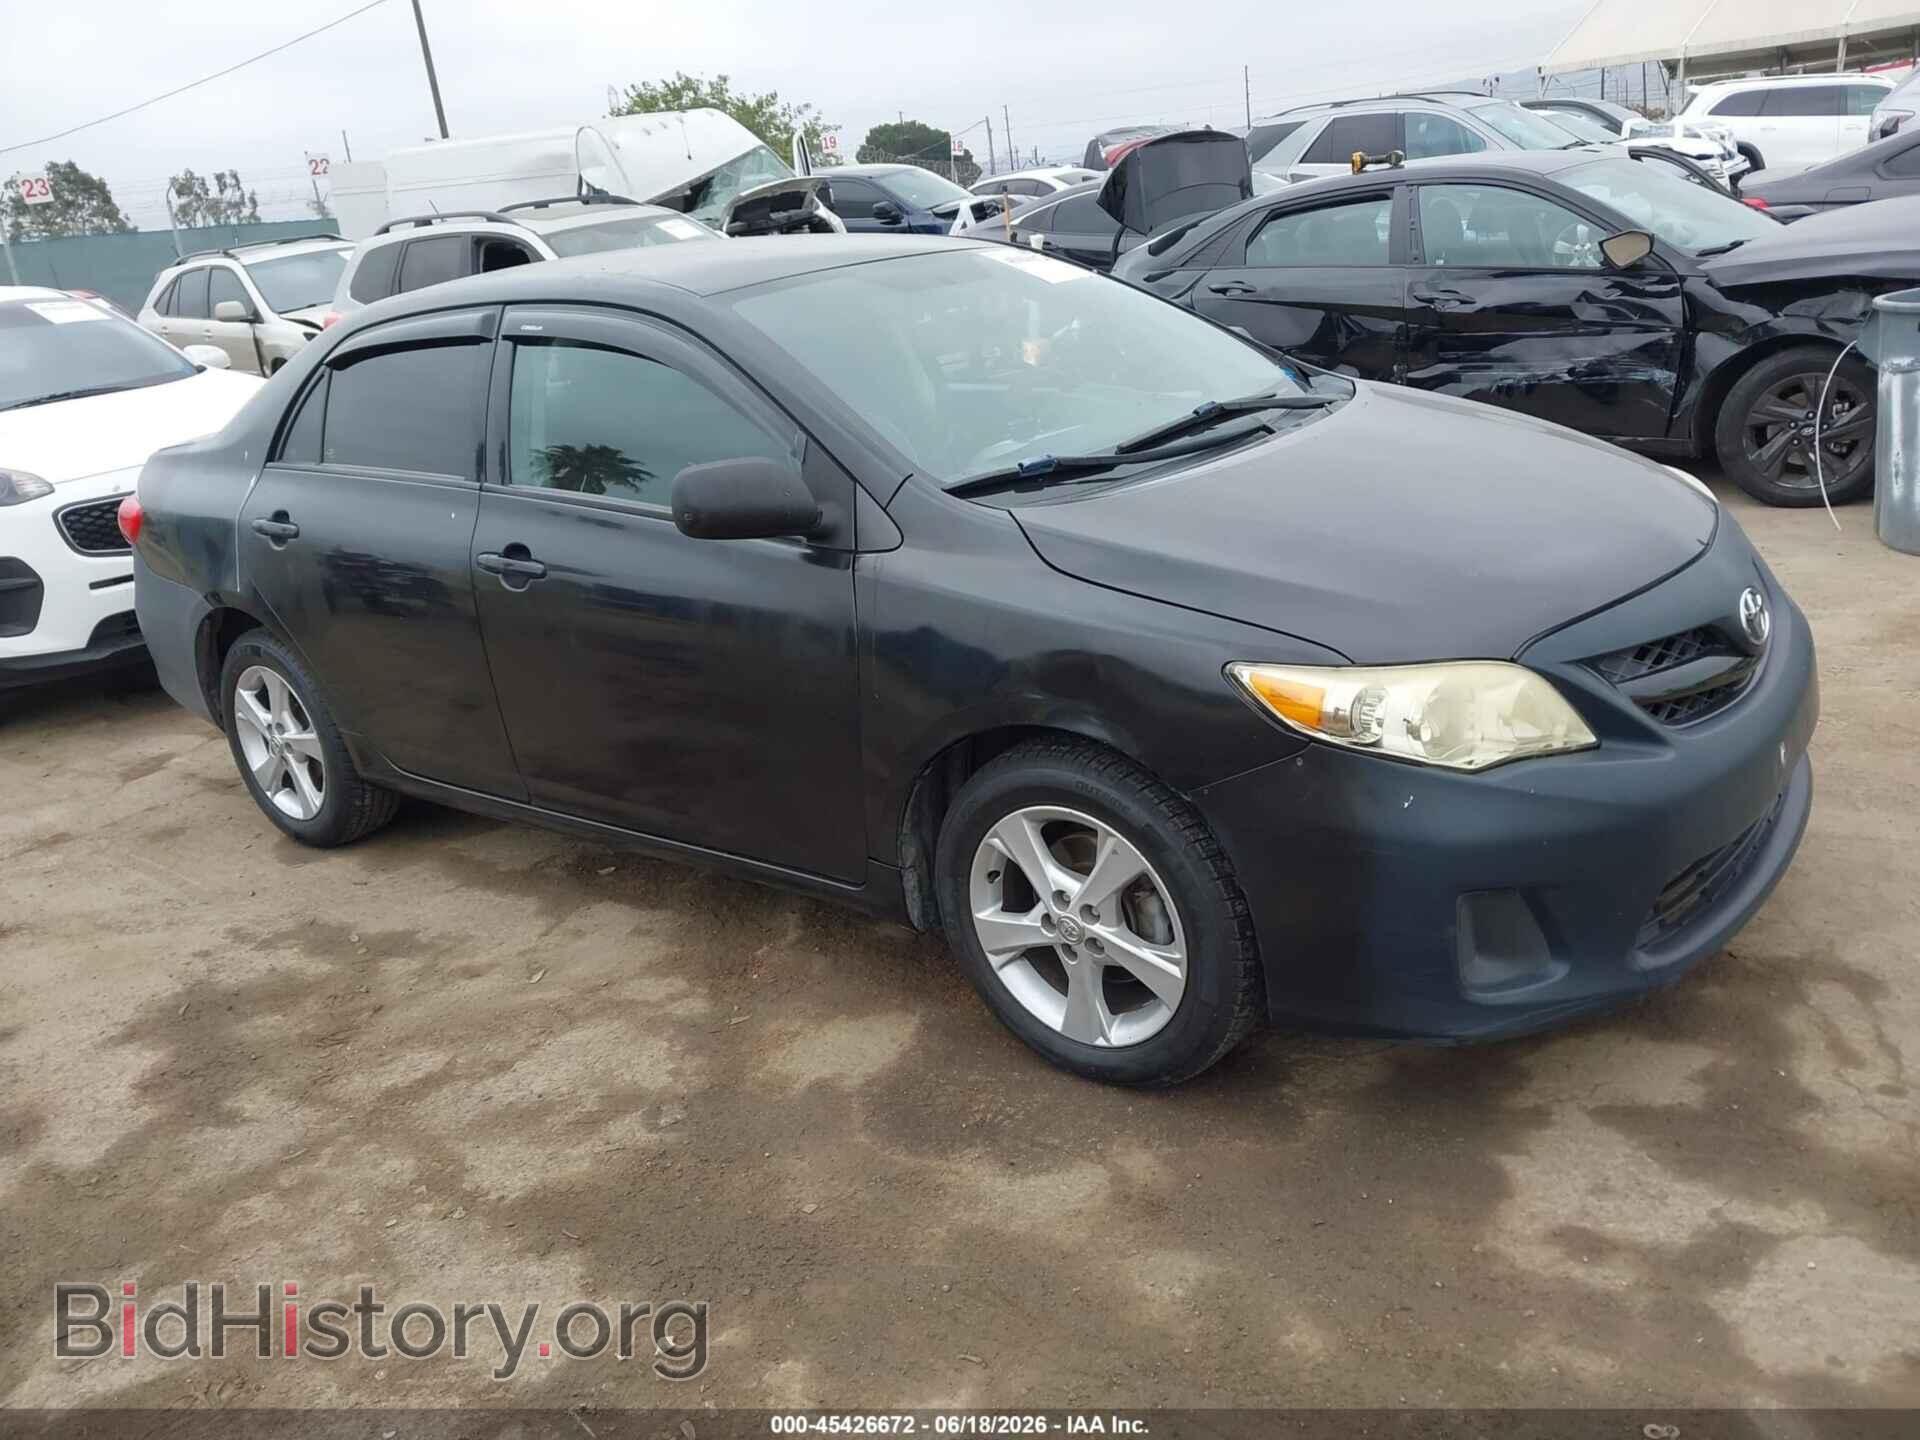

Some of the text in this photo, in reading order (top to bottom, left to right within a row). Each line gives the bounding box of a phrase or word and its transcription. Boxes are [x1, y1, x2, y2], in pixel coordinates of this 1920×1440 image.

[823, 135, 838, 149] 19
[952, 140, 963, 152] 18
[308, 158, 330, 176] 22
[21, 178, 50, 199] 23
